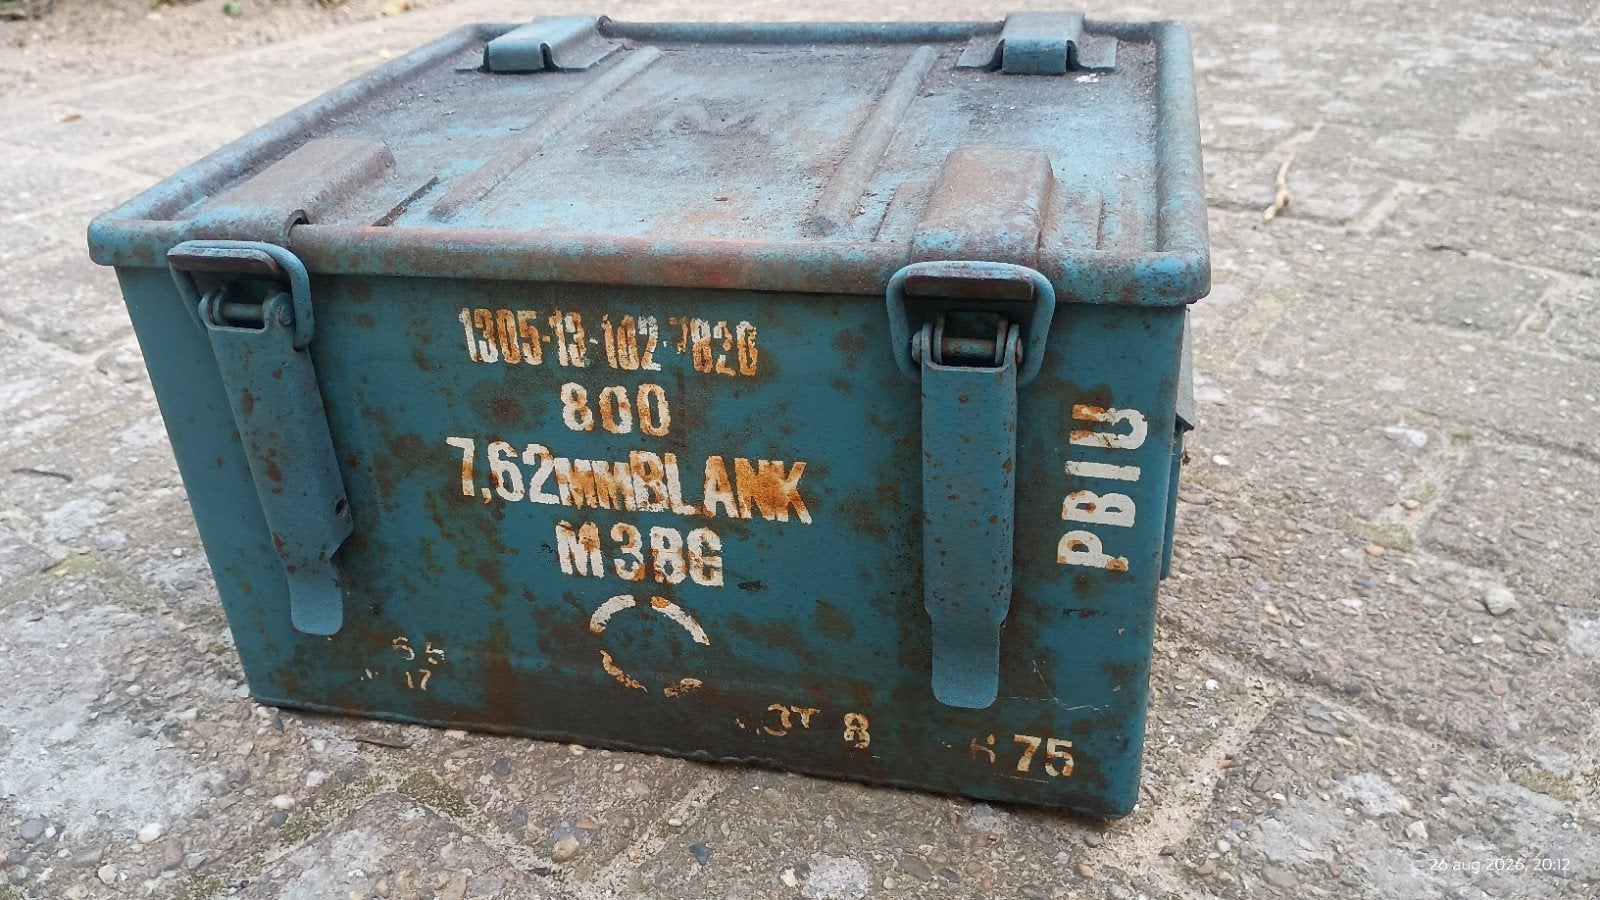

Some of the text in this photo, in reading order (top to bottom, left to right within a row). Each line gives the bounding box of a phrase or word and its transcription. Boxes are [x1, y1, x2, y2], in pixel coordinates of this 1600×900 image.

[560, 382, 671, 436] 800
[1056, 403, 1148, 572] PBIU
[1014, 733, 1075, 778] 75
